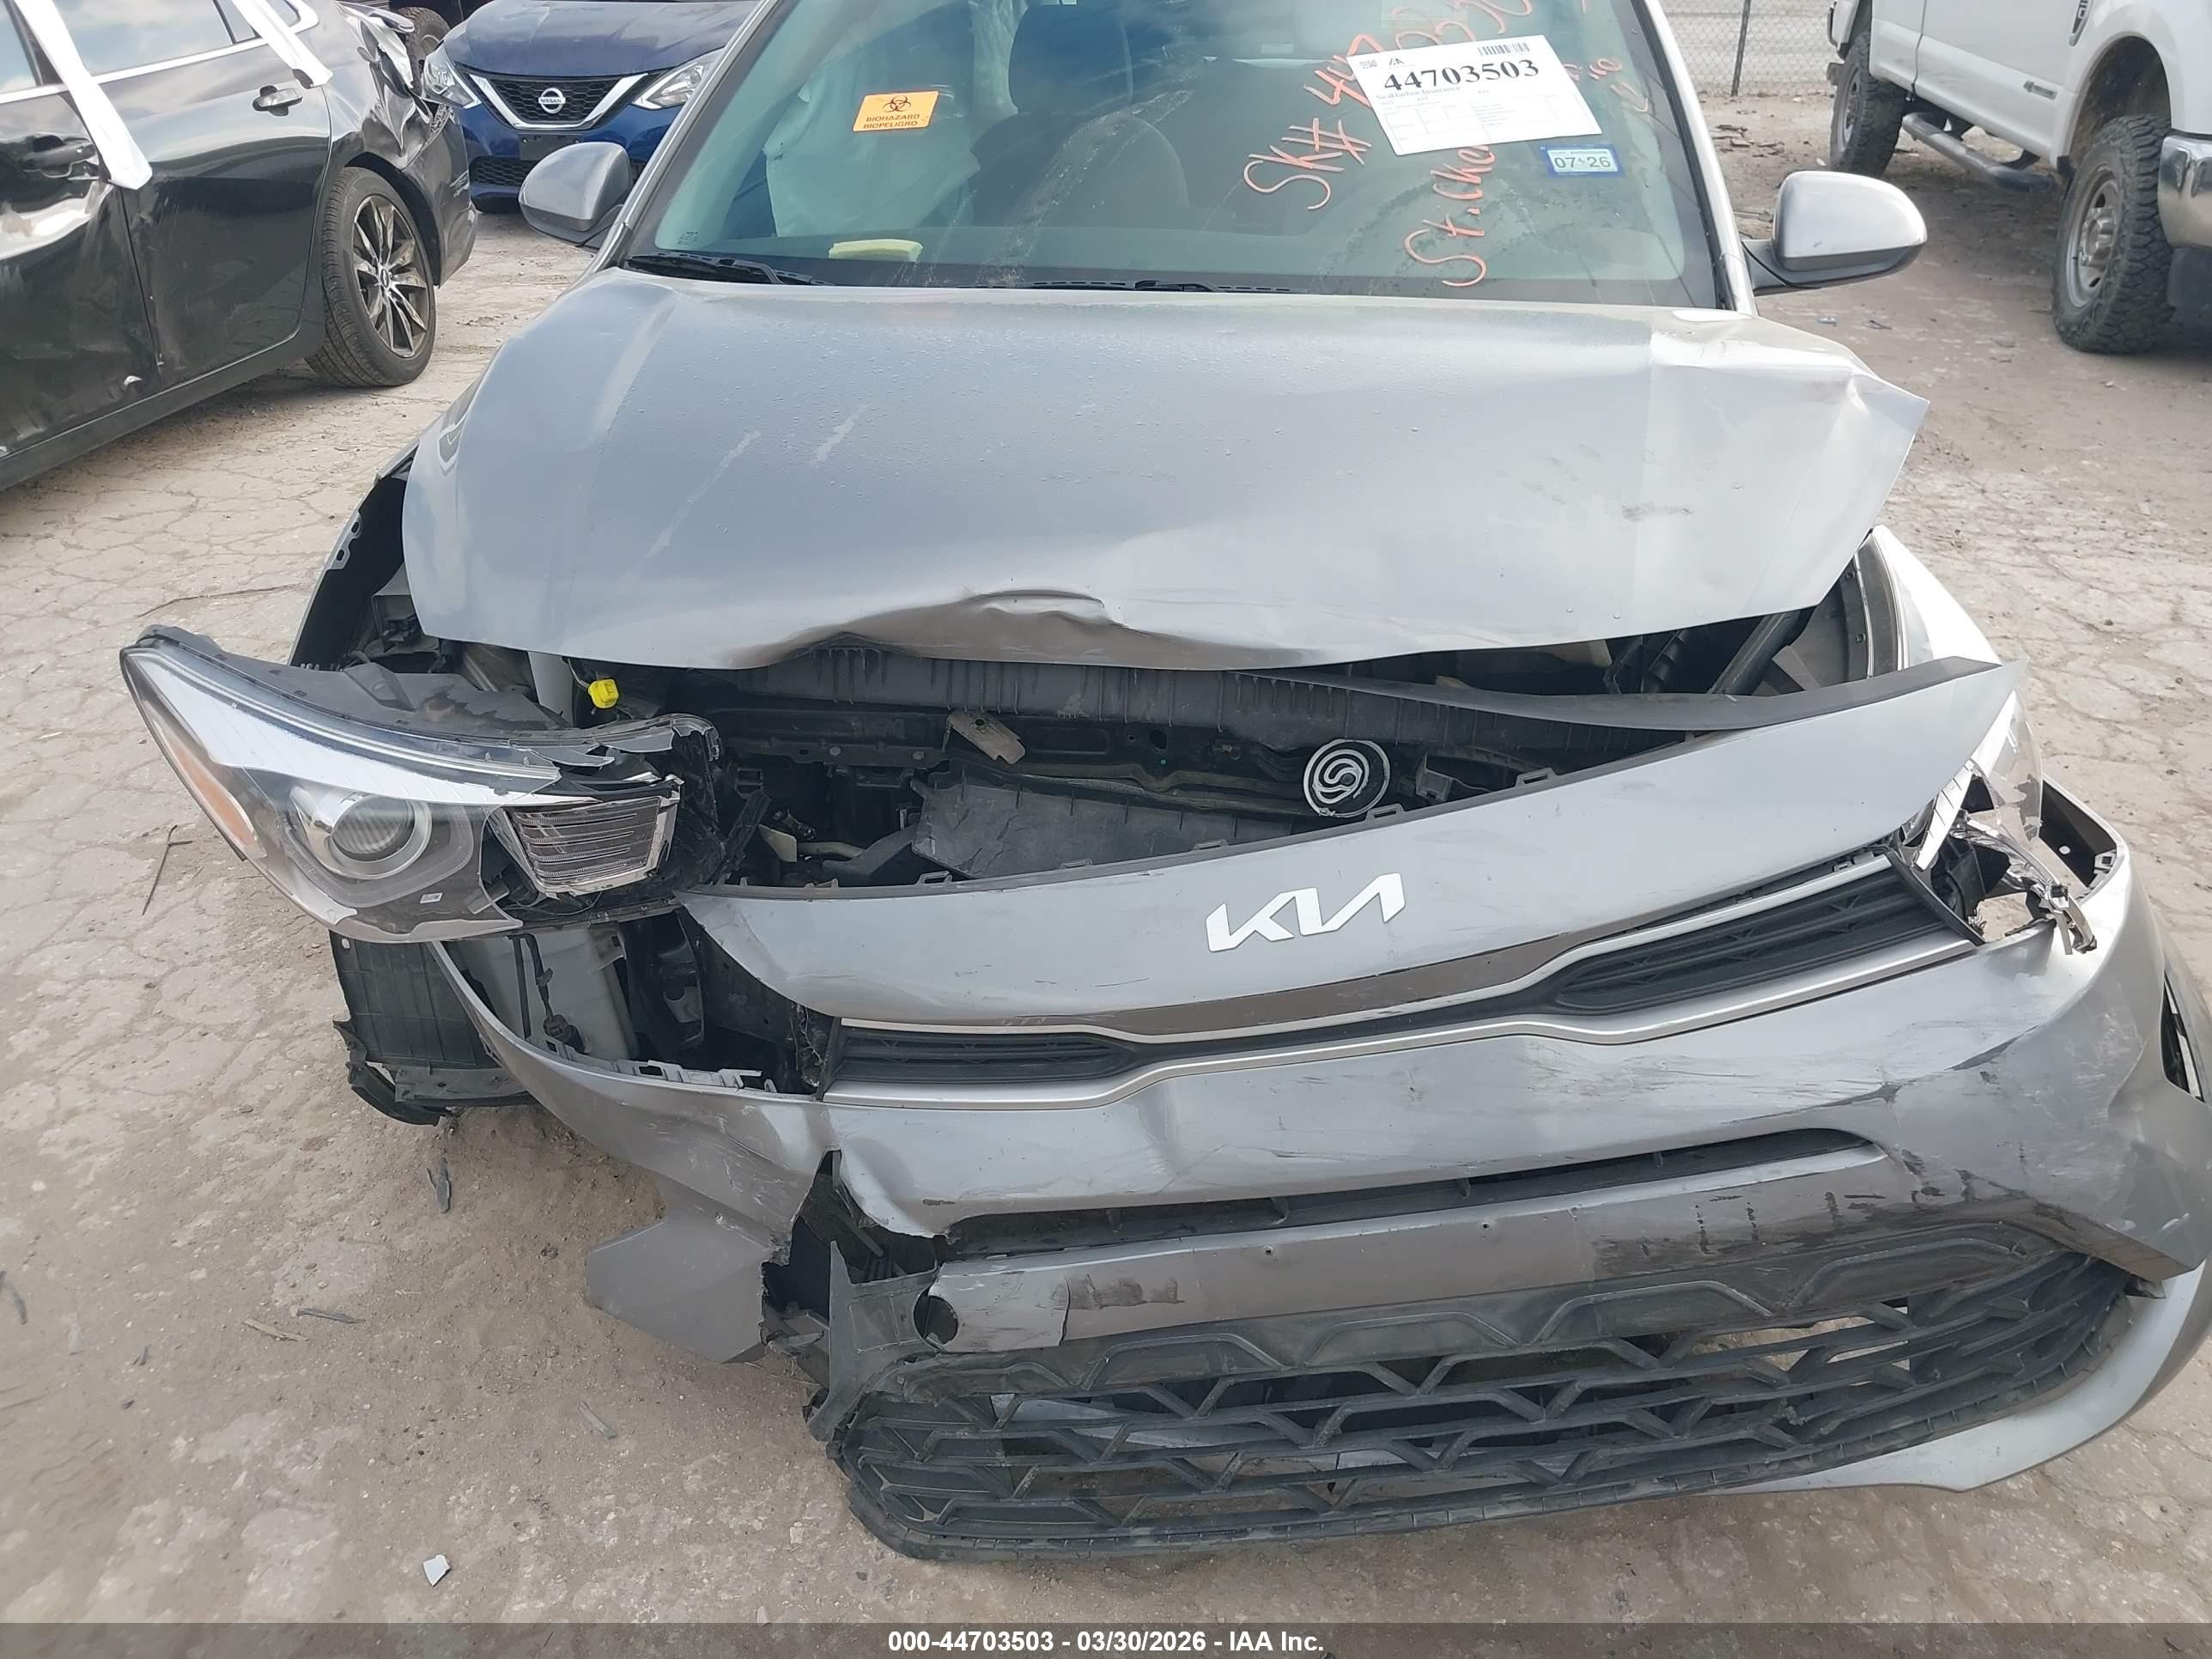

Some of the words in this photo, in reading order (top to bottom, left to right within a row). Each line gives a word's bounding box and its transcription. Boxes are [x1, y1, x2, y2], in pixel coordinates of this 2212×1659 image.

[1384, 59, 1540, 91] 44703503
[866, 113, 921, 123] BIOHAZARD
[863, 120, 919, 130] BIOPELIGRO
[1553, 157, 1576, 168] 07
[1586, 156, 1611, 167] 26
[1206, 872, 1406, 953] KIA
